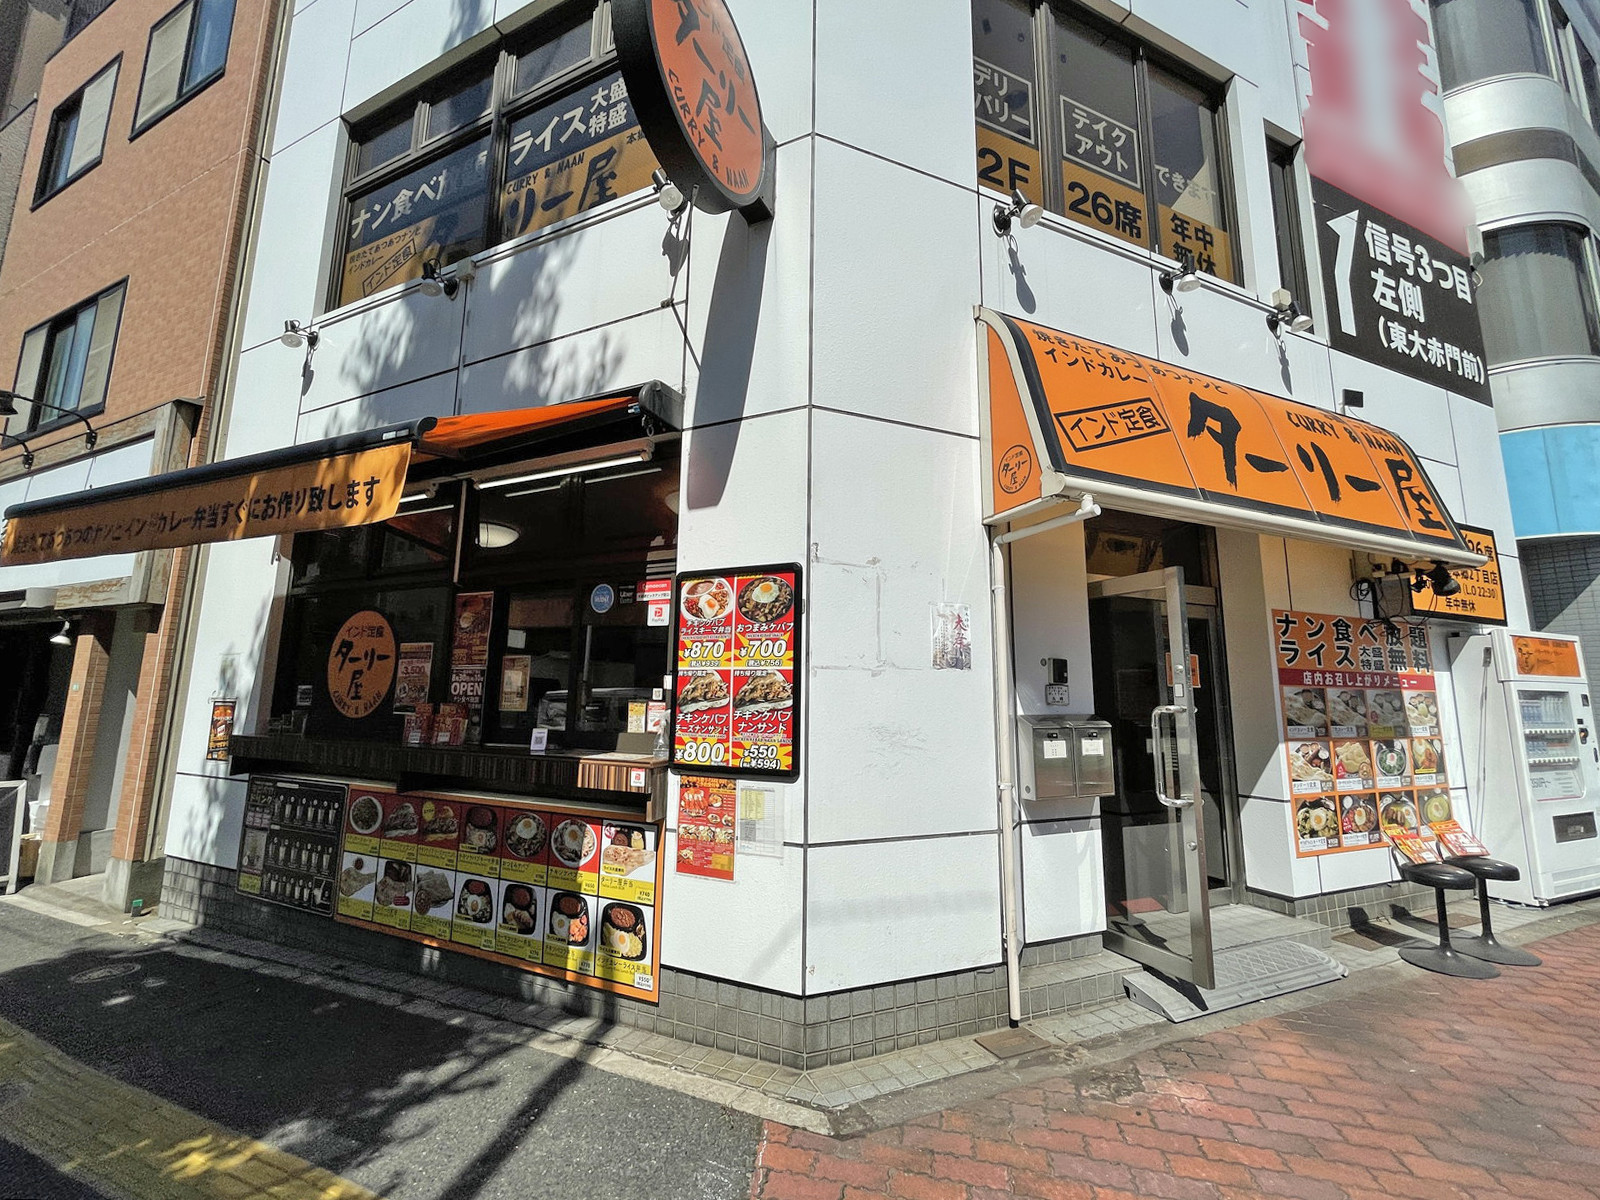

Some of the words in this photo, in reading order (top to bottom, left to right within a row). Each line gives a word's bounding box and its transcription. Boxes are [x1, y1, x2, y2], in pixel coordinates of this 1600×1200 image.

[589, 77, 628, 113] 大盛
[668, 68, 705, 149] CURRY
[510, 106, 587, 166] ライス
[588, 101, 628, 138] 特盛
[1071, 107, 1127, 148] テイク
[978, 147, 1030, 190] 2F
[1074, 133, 1129, 173] アウト
[507, 173, 538, 195] CURRY
[557, 152, 586, 175] NAAN
[1067, 181, 1142, 239] 26席
[1170, 212, 1214, 252] 年中
[365, 245, 412, 289] インド定食
[1363, 220, 1472, 305] 信号3つ目
[1371, 267, 1425, 323] 左側
[1044, 348, 1149, 384] インドカレー
[1378, 316, 1485, 386] (東大赤門前)
[1069, 405, 1162, 442] インド定食
[1286, 410, 1340, 440] CURRY
[1361, 432, 1404, 457] NAAN
[1002, 460, 1028, 478] ターリー
[1187, 391, 1448, 531] ターリー屋
[1445, 596, 1477, 613] 年中無休
[346, 625, 385, 639] インド定食
[736, 622, 794, 633] おつまみケバブ
[1275, 612, 1428, 650] ナン食べ放題
[335, 638, 391, 672] ターリー
[683, 641, 725, 659] ¥870
[739, 640, 787, 658] ¥700
[1279, 639, 1356, 669] ライス
[1358, 646, 1384, 659] 大盛
[1387, 647, 1432, 674] 無料
[347, 669, 364, 701] 屋
[451, 682, 482, 696] OPEN
[1303, 671, 1418, 688] 店内お召し上がりメニュー
[675, 725, 730, 735] チーズナンサンド
[676, 713, 729, 724] チキンケバブ
[733, 710, 792, 722] チキンケバブ
[738, 722, 788, 733] ナンサンド
[675, 741, 725, 763] ¥800
[744, 744, 777, 759] ¥550
